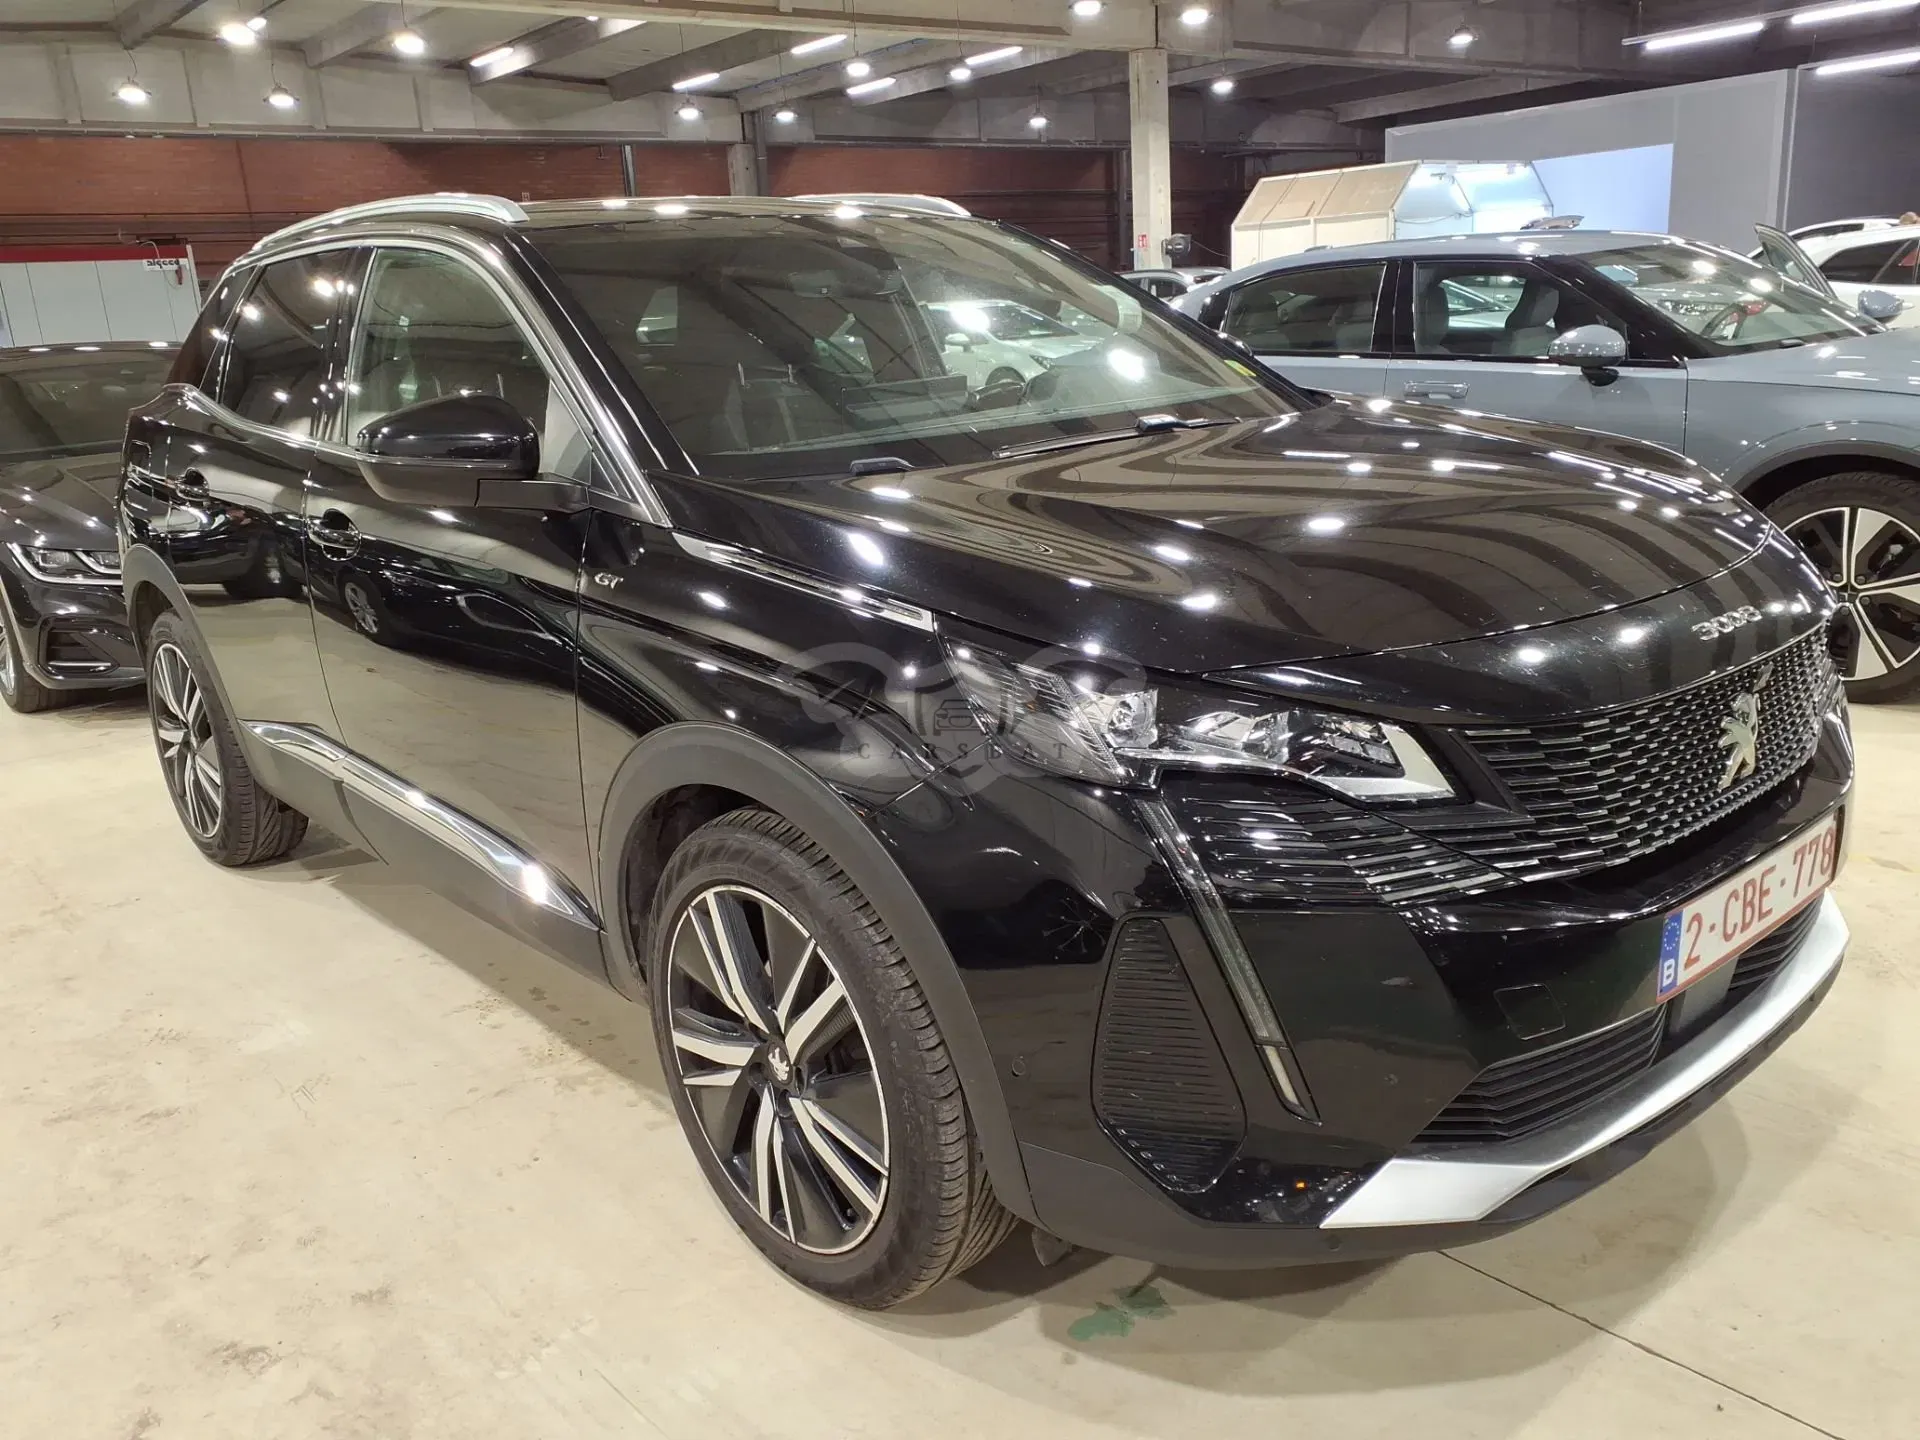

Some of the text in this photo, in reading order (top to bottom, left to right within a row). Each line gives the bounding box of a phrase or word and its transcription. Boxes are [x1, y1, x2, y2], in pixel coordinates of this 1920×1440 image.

[594, 572, 624, 589] GT
[1691, 605, 1763, 641] 3008
[1662, 958, 1675, 988] B
